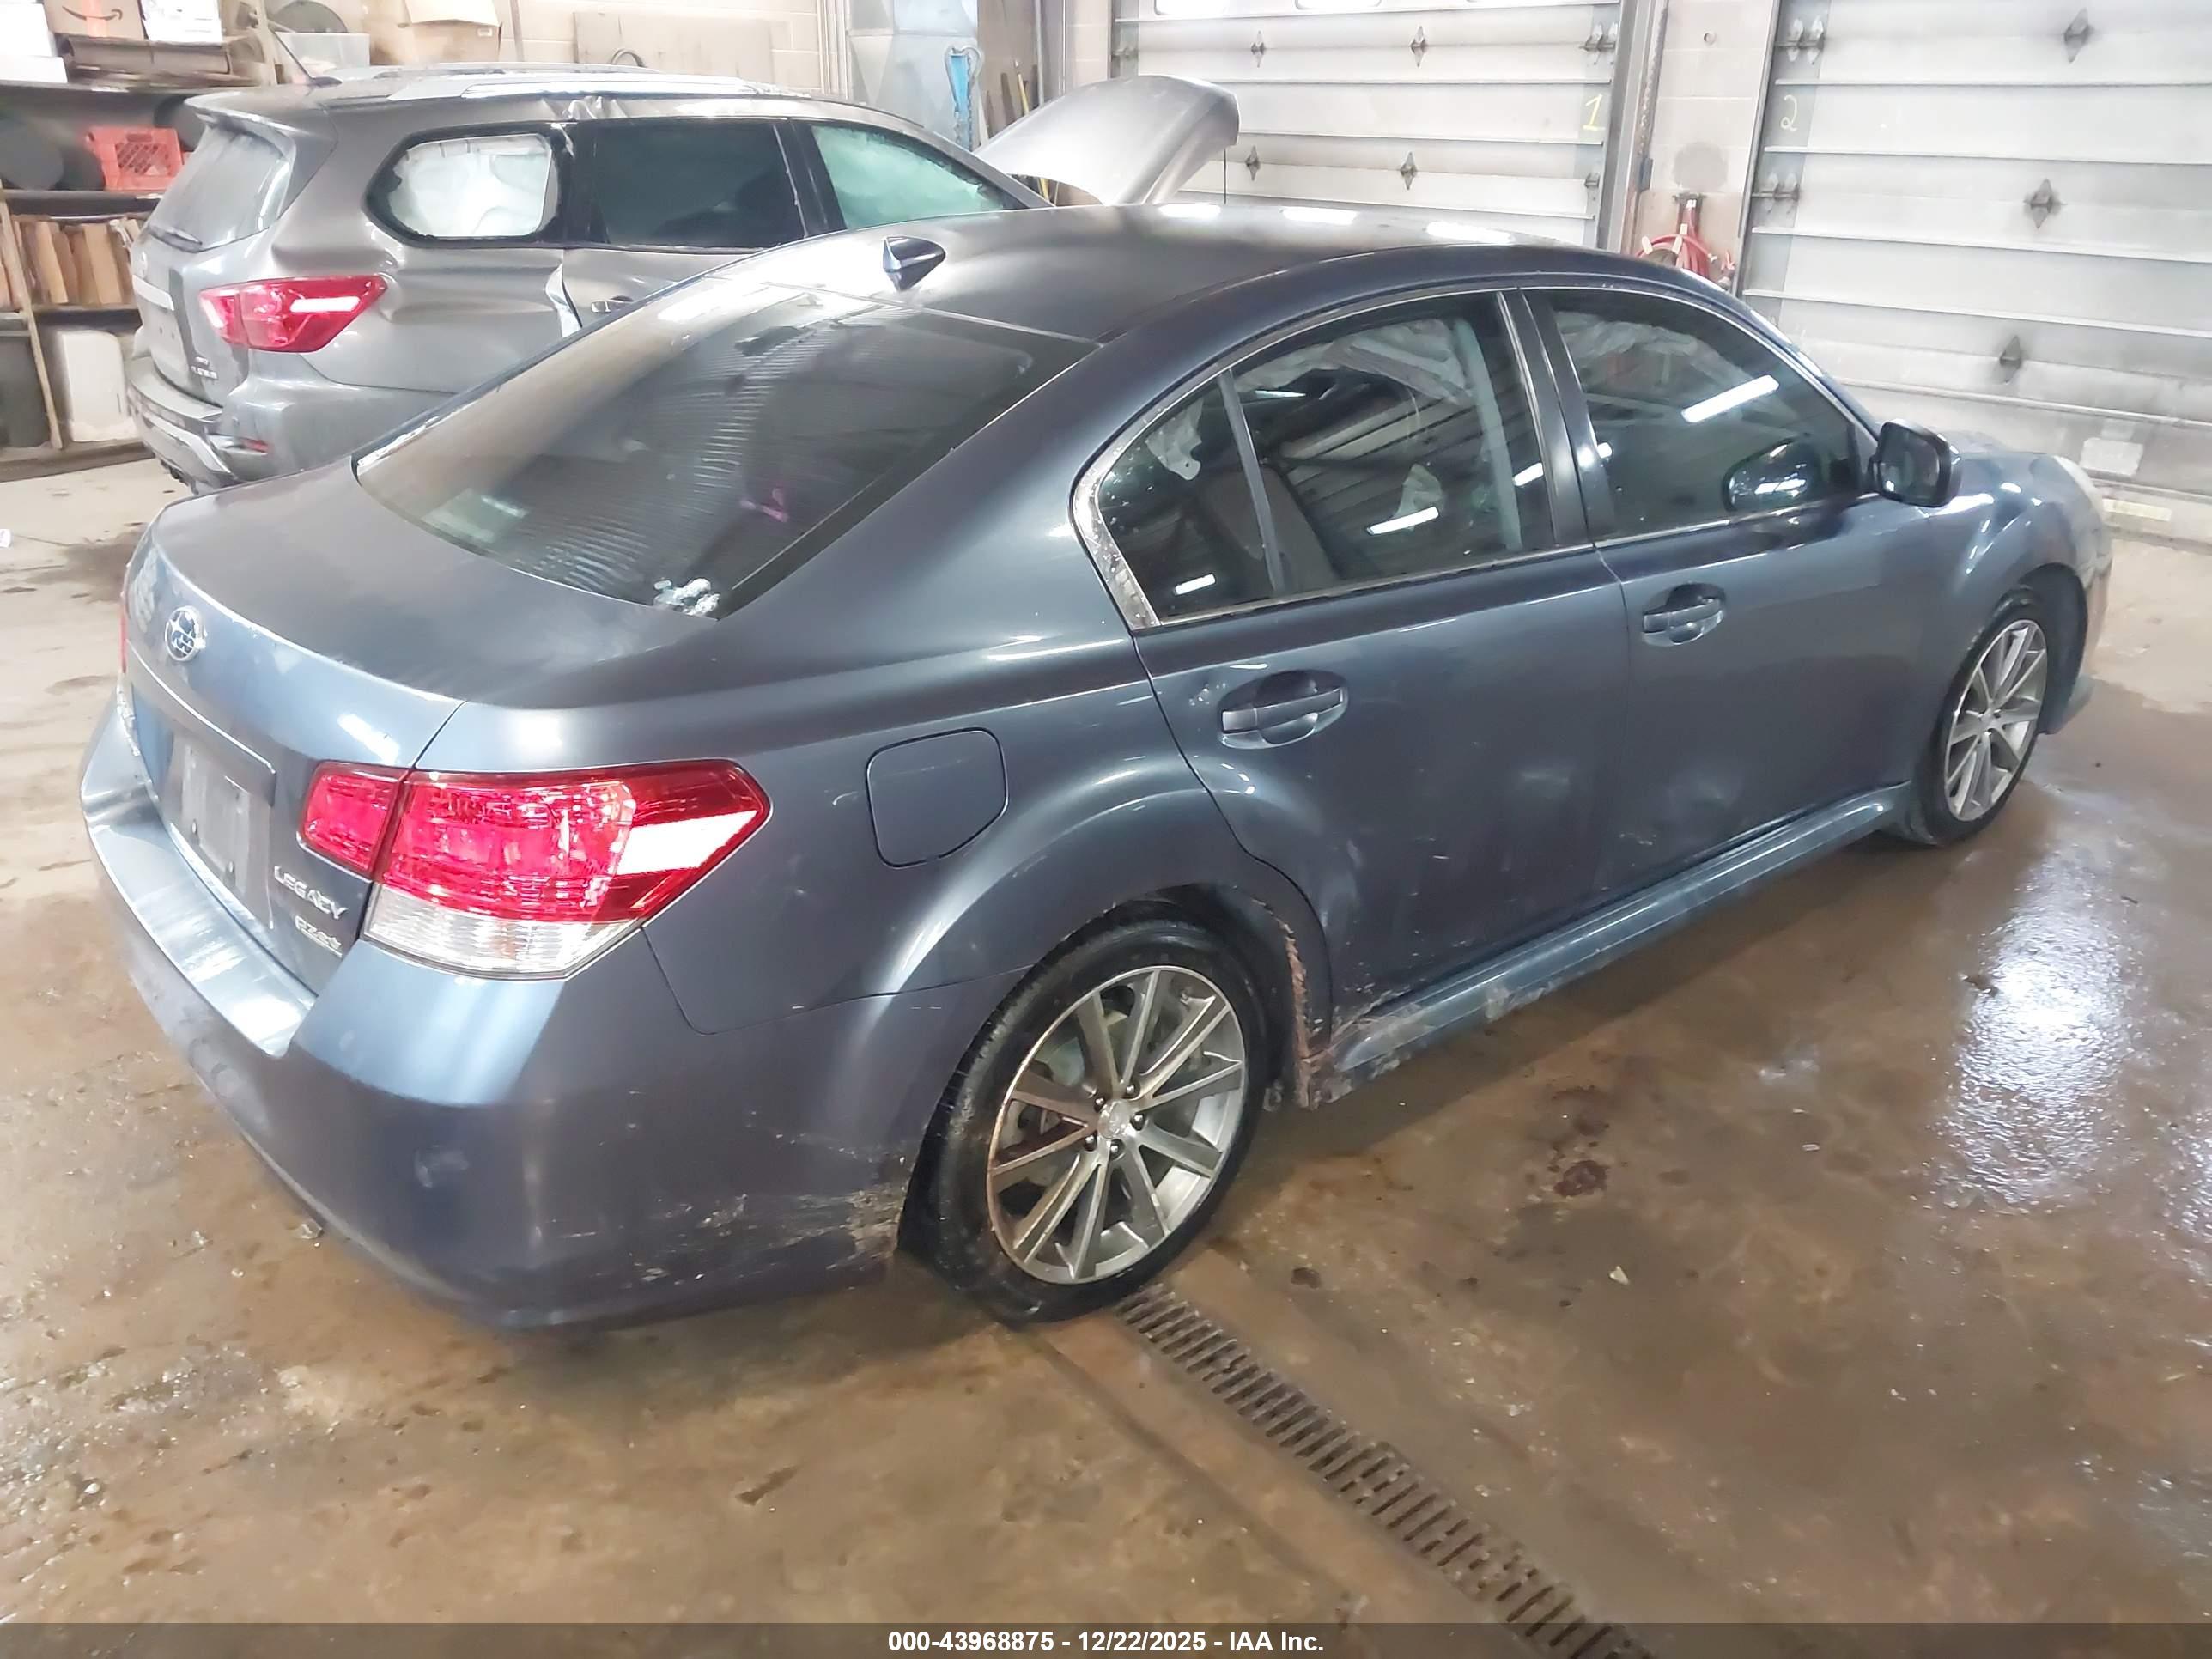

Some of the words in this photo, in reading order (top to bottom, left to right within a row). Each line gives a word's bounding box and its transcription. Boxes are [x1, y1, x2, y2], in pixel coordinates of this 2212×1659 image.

[1583, 94, 1606, 131] 1
[1780, 94, 1798, 131] 2
[274, 866, 349, 919] LEGACY
